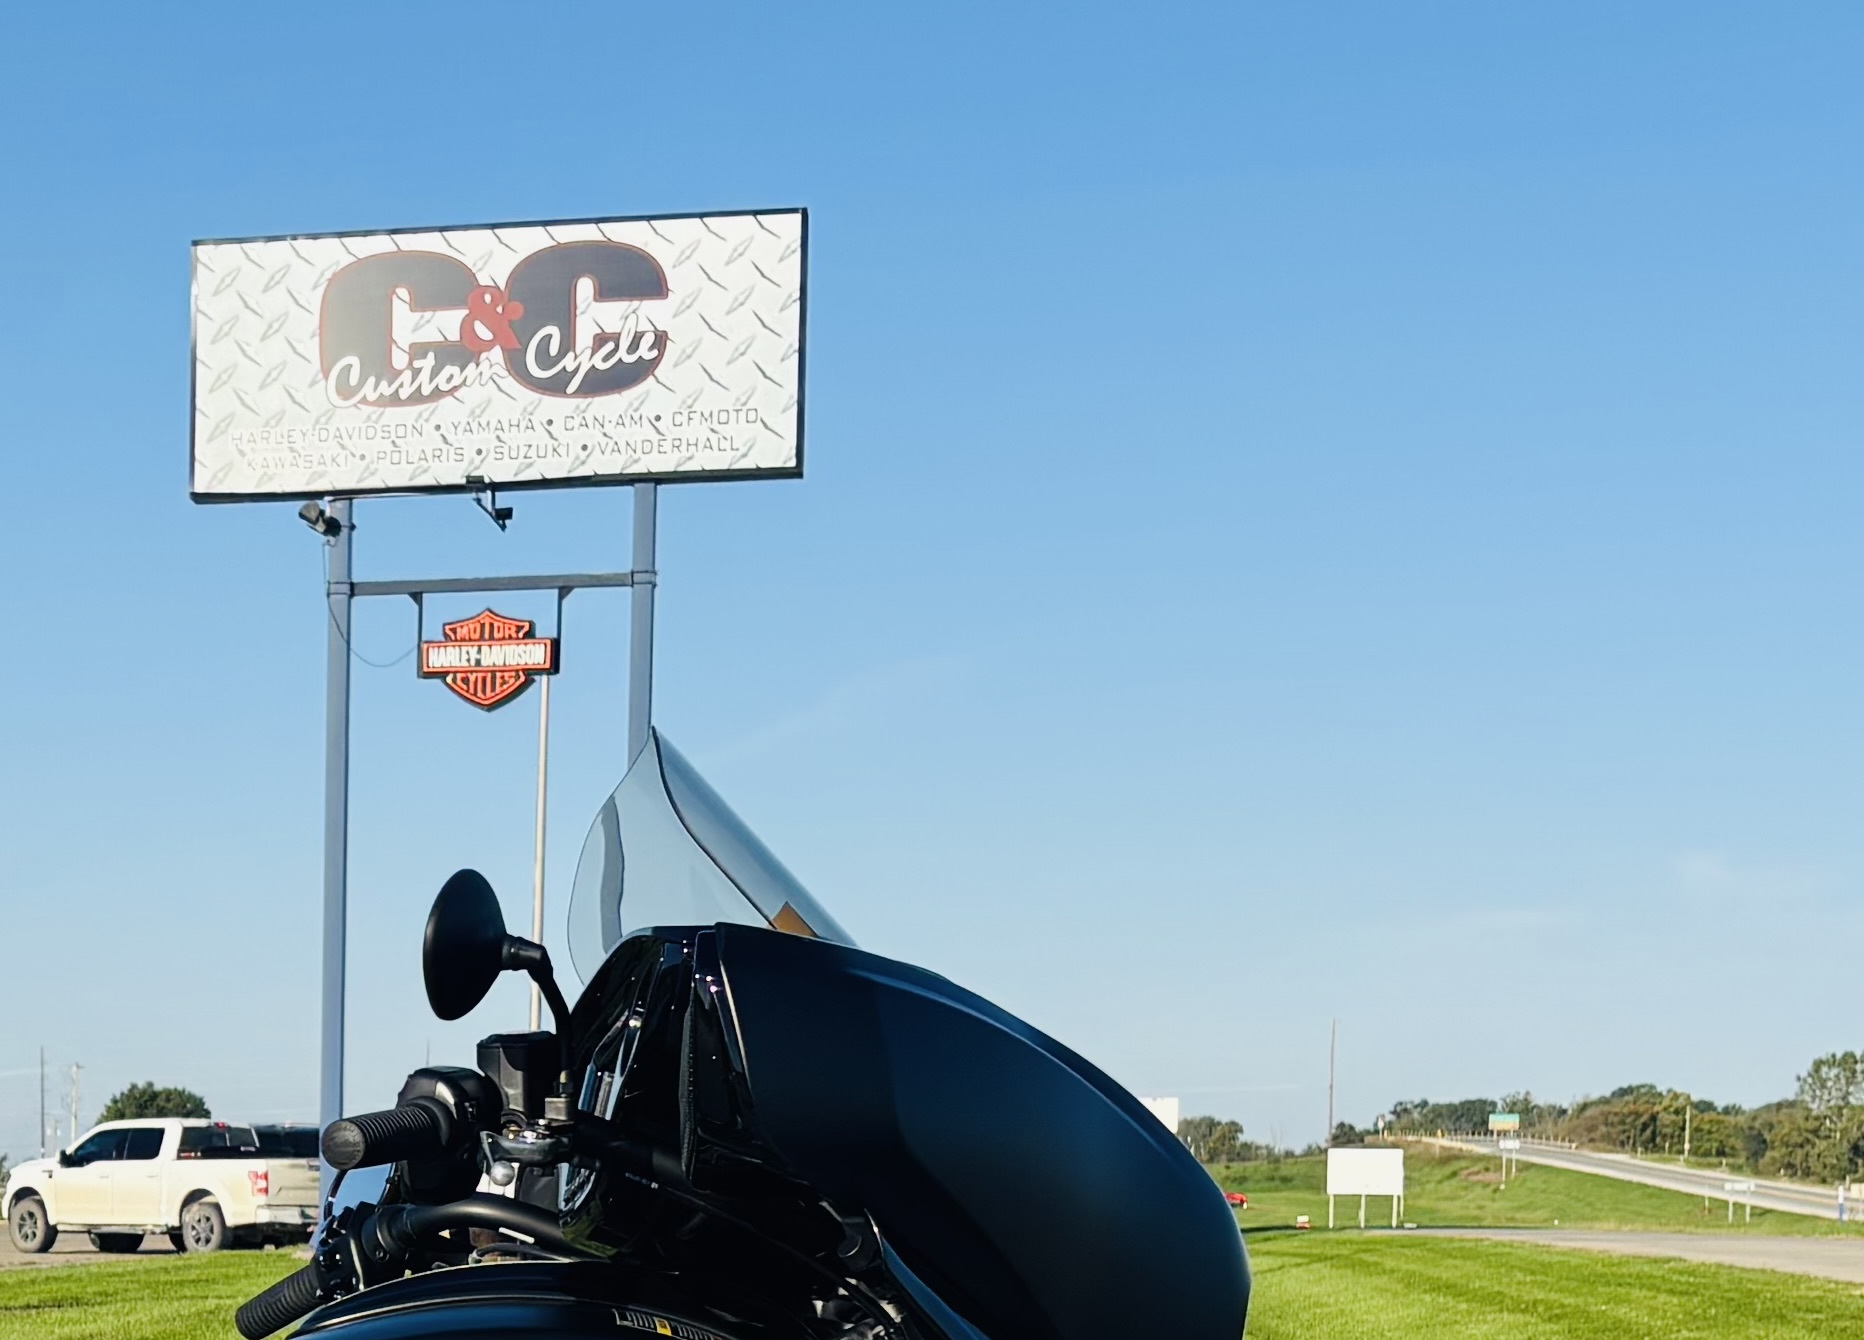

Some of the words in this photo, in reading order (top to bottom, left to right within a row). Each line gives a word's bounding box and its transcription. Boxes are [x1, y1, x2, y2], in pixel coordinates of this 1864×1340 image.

[319, 240, 669, 408] C&C
[326, 345, 509, 408] Custom
[525, 309, 660, 395] Cycle
[230, 422, 424, 446] HARLEY-DAVIDSON
[451, 417, 536, 437] YAMAHA
[563, 413, 643, 431] CAN-AM
[672, 407, 759, 428] CFMOTO
[246, 451, 349, 472] KAWASAKI
[376, 447, 465, 466] POLARIS
[493, 442, 570, 461] SUZUKI
[598, 435, 740, 455] VANDERHALL
[456, 620, 519, 640] MOTOR
[428, 642, 546, 668] HARLEY-DAVIDSON
[456, 672, 517, 698] CYCLES
